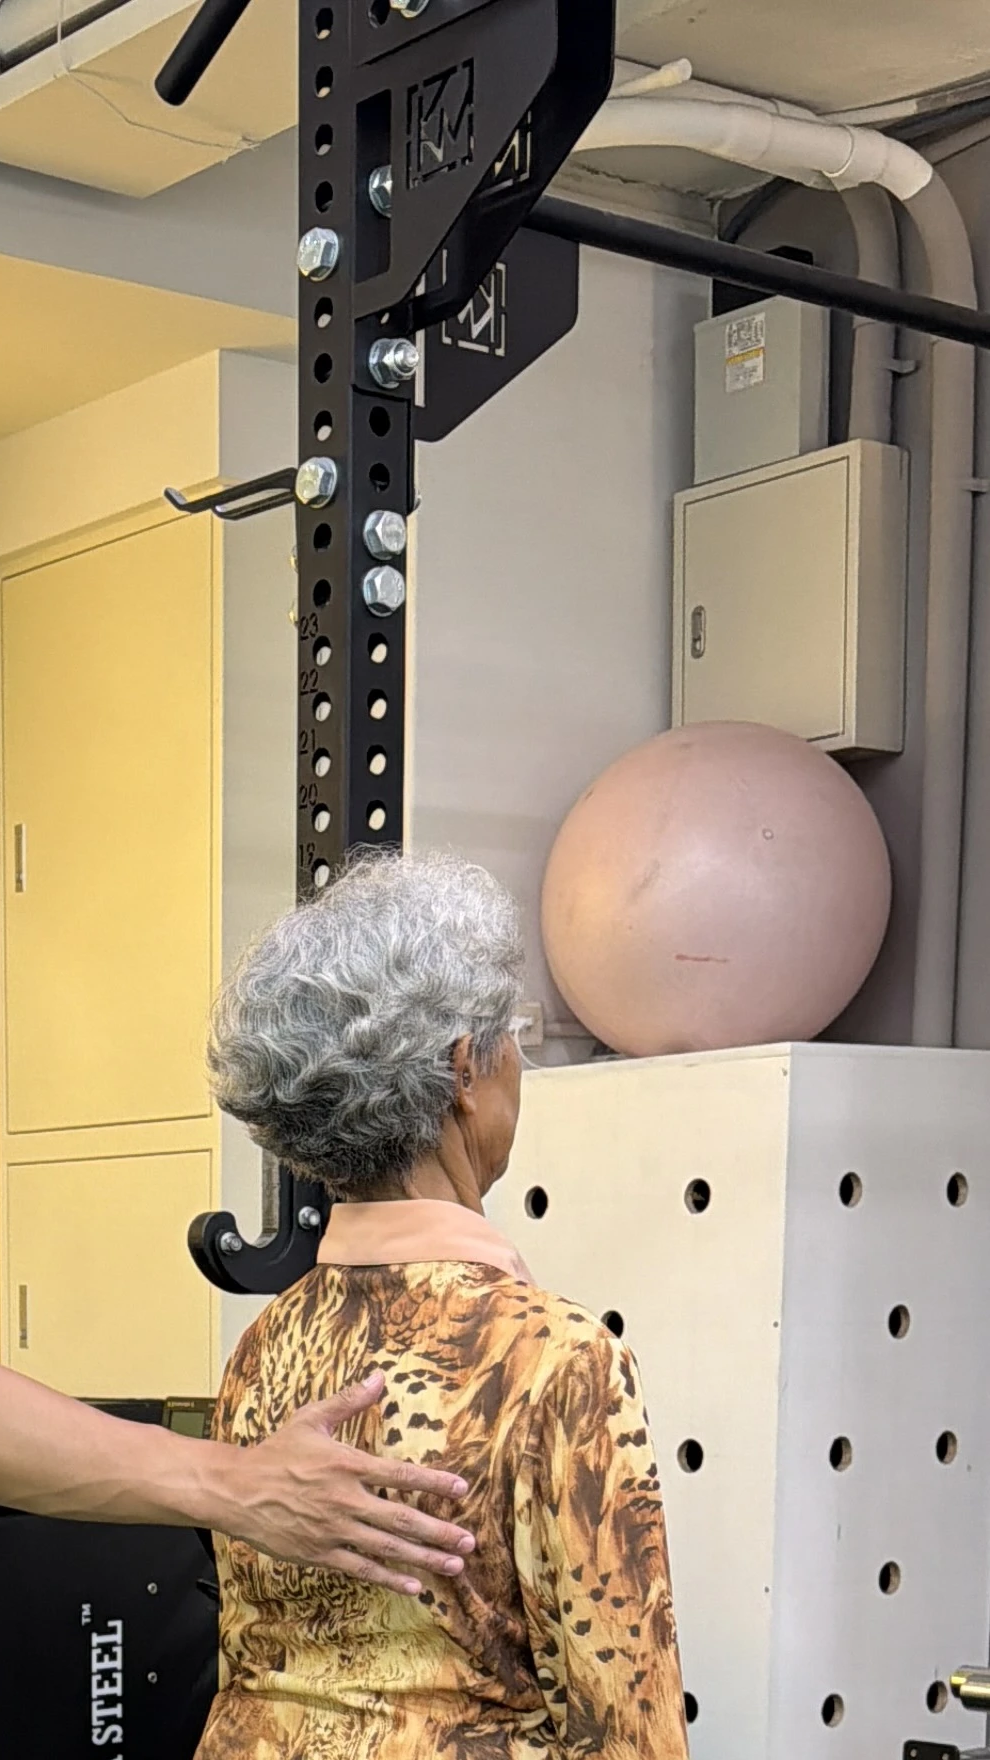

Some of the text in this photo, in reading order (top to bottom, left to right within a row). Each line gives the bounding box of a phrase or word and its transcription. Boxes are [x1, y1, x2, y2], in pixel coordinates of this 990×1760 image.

[300, 668, 319, 695] 22
[299, 728, 316, 755] 21
[298, 783, 318, 809] 20
[92, 1619, 123, 1746] STEEL
